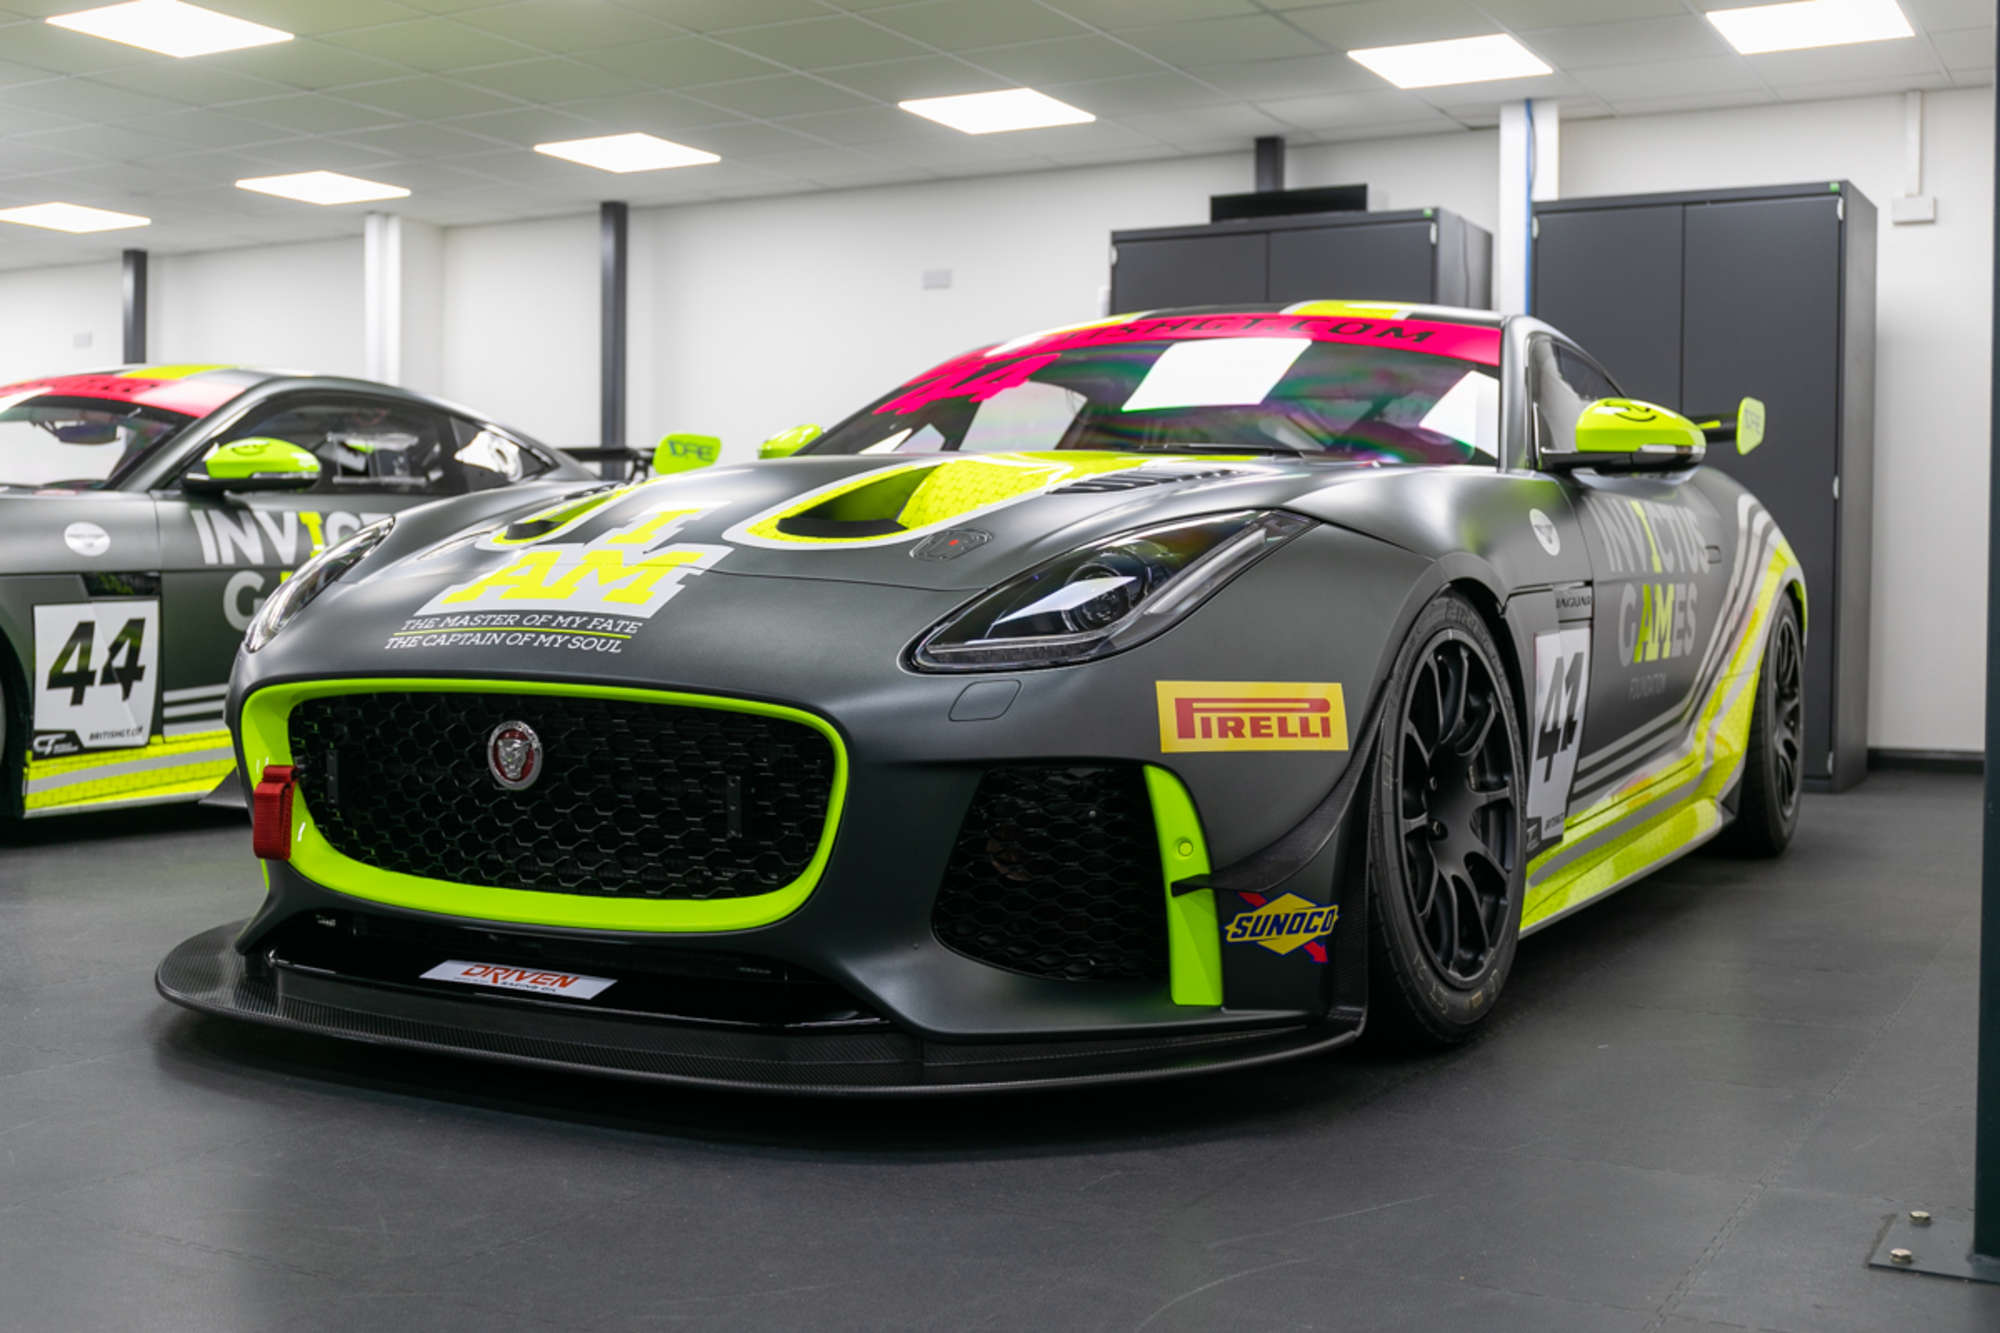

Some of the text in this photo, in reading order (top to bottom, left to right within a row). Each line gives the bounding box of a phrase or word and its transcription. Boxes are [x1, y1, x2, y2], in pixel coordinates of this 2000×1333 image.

[1581, 496, 1711, 574] INVICTUS
[440, 549, 706, 606] AM
[384, 632, 623, 653] THE CAPTAIN OF MY SOUL
[400, 614, 643, 634] THE MASTER OF MY FATE
[1618, 581, 1699, 668] GAMES
[46, 617, 147, 707] 44
[1174, 697, 1332, 740] PIRELLI
[1230, 907, 1337, 939] SUNOCO
[461, 963, 580, 989] DRIVEN
